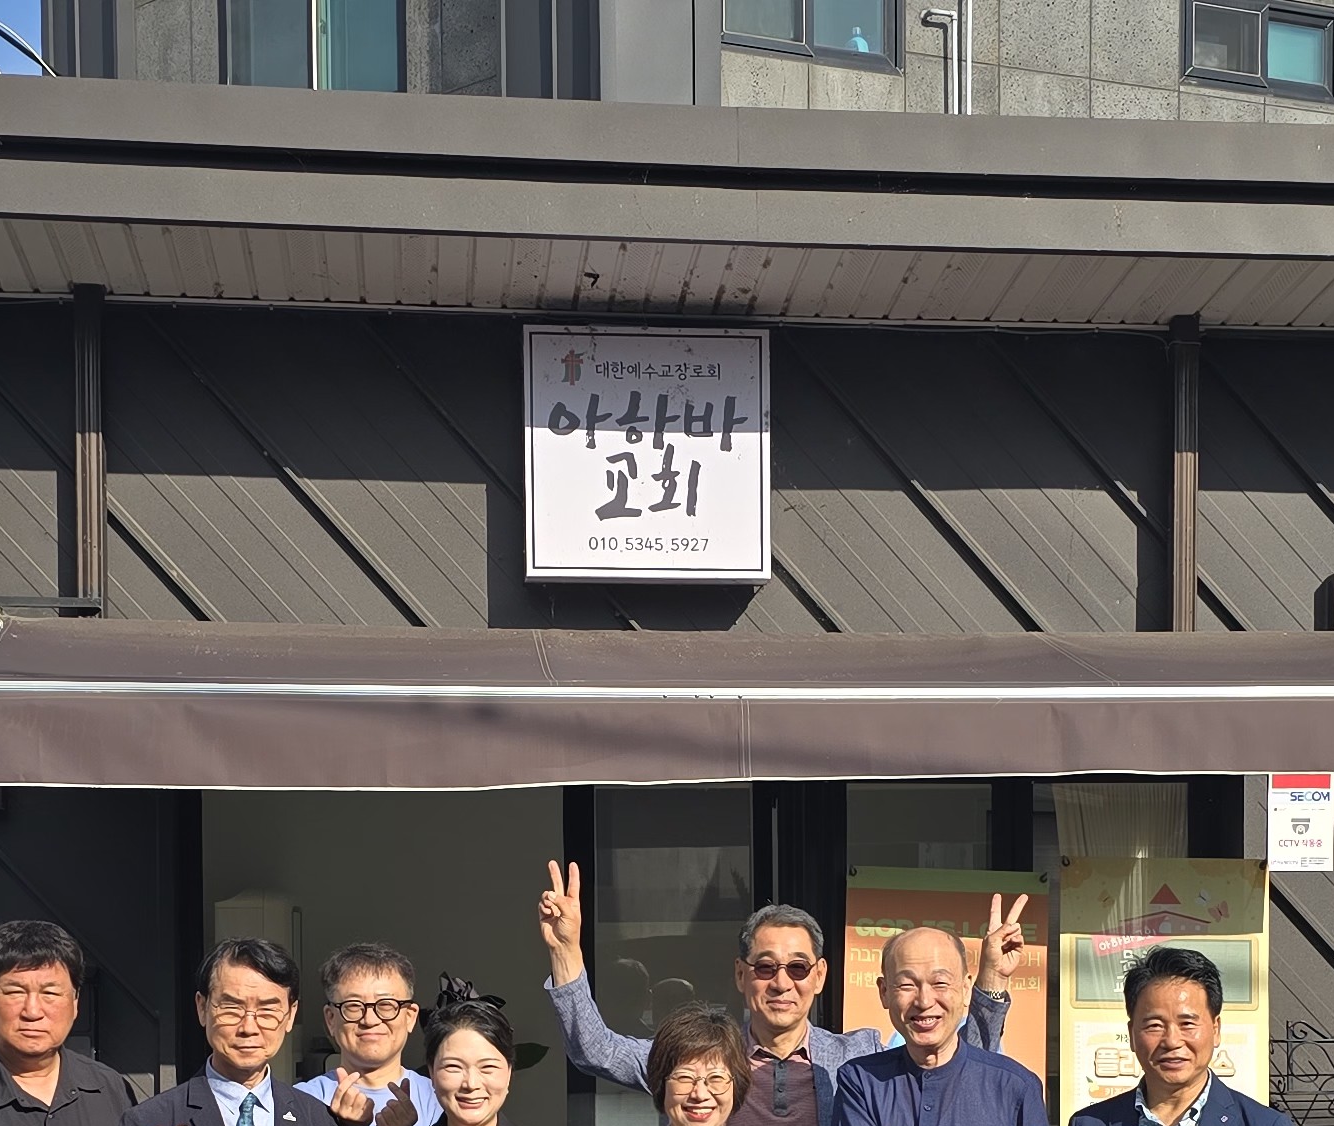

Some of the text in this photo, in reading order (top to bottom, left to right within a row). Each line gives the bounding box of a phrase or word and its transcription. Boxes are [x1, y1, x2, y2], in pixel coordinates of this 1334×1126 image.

[595, 361, 722, 381] 대한예수교장로회
[595, 443, 702, 521] 교회
[1290, 791, 1331, 801] SECOM
[1278, 839, 1300, 848] CCTV
